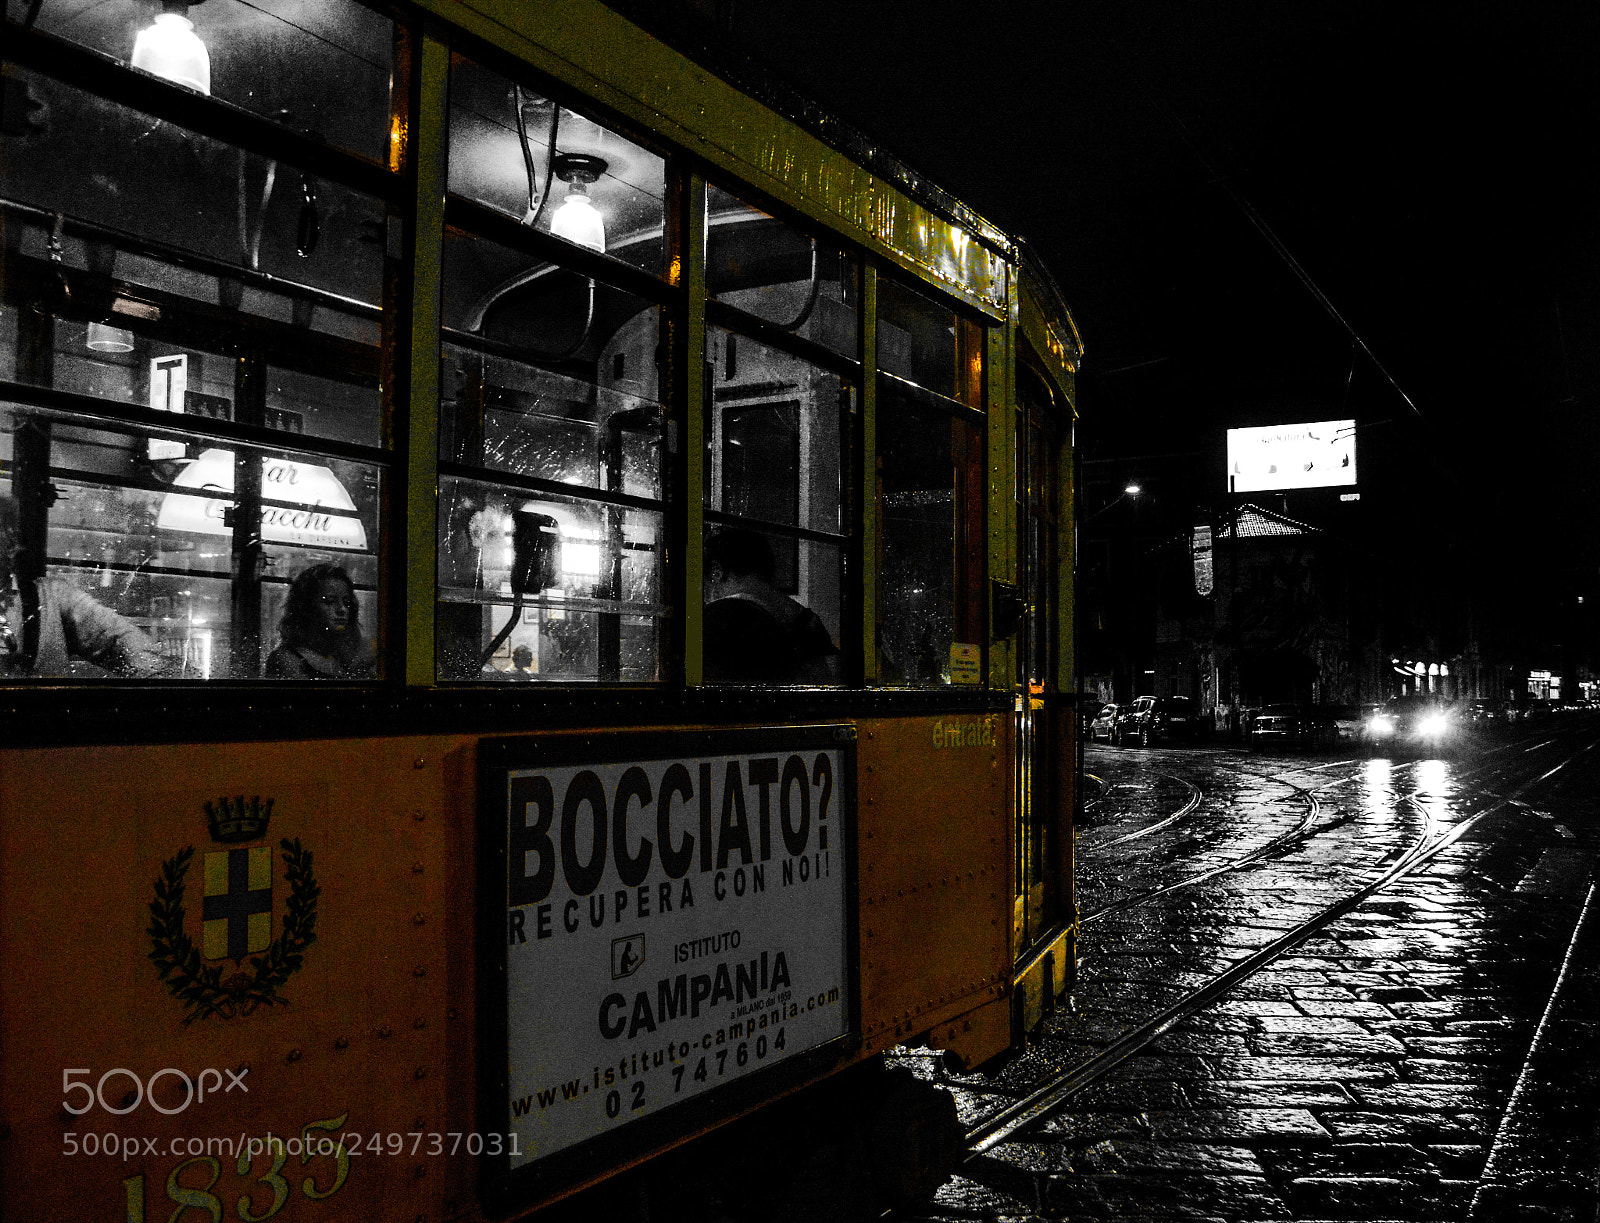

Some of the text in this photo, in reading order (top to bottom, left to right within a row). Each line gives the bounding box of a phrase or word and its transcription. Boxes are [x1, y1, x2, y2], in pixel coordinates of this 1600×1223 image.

[264, 459, 299, 486] ar
[507, 752, 834, 908] BOCCIATO?
[508, 852, 830, 946] RECUPERA CON NOI!
[674, 930, 742, 964] ISTITUTO
[598, 950, 792, 1040] CAMPANIA
[736, 999, 765, 1018] MILANO
[765, 995, 776, 1008] dal
[511, 986, 840, 1118] www.istituto-campania.com
[605, 1026, 787, 1119] 02 747604
[121, 1112, 353, 1223] 1835
